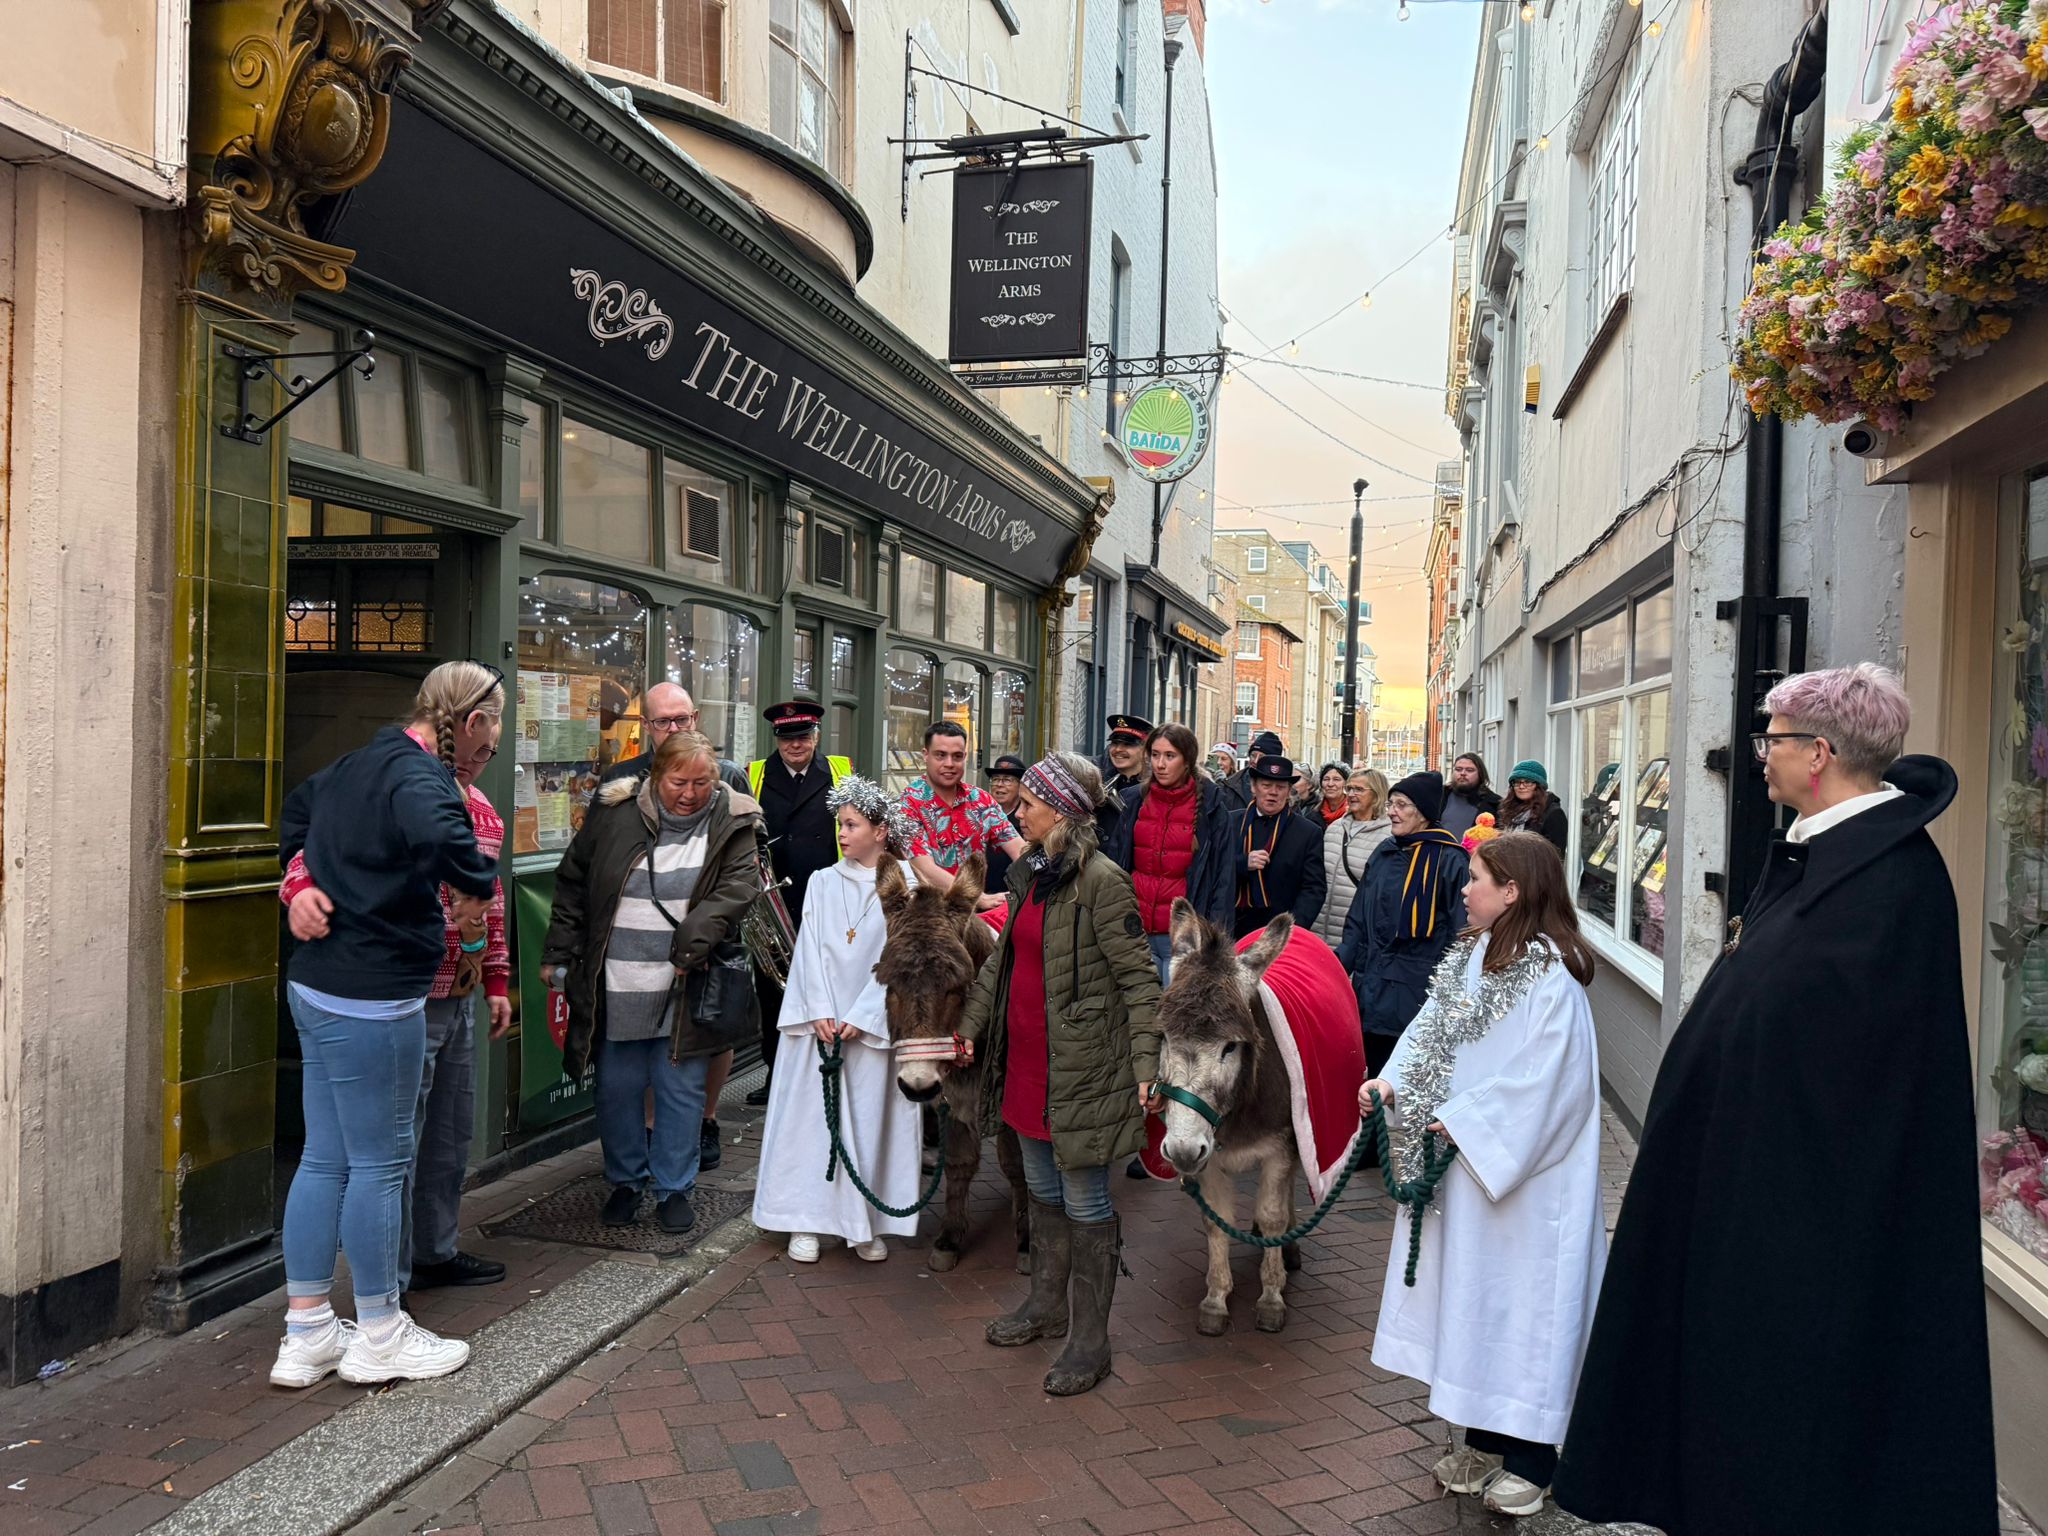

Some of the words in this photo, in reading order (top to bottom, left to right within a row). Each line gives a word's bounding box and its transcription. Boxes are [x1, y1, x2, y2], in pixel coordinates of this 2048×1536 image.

[1004, 231, 1039, 246] THE
[968, 254, 1073, 273] WELLINGTON
[998, 284, 1042, 298] ARMS
[975, 374, 994, 384] Great
[996, 373, 1013, 382] Food
[1015, 371, 1036, 381] Served
[1038, 371, 1056, 380] Here
[681, 321, 779, 420] THE
[777, 376, 959, 514] WELLINGTON
[945, 484, 1007, 540] ARMS
[563, 1083, 576, 1099] NOV
